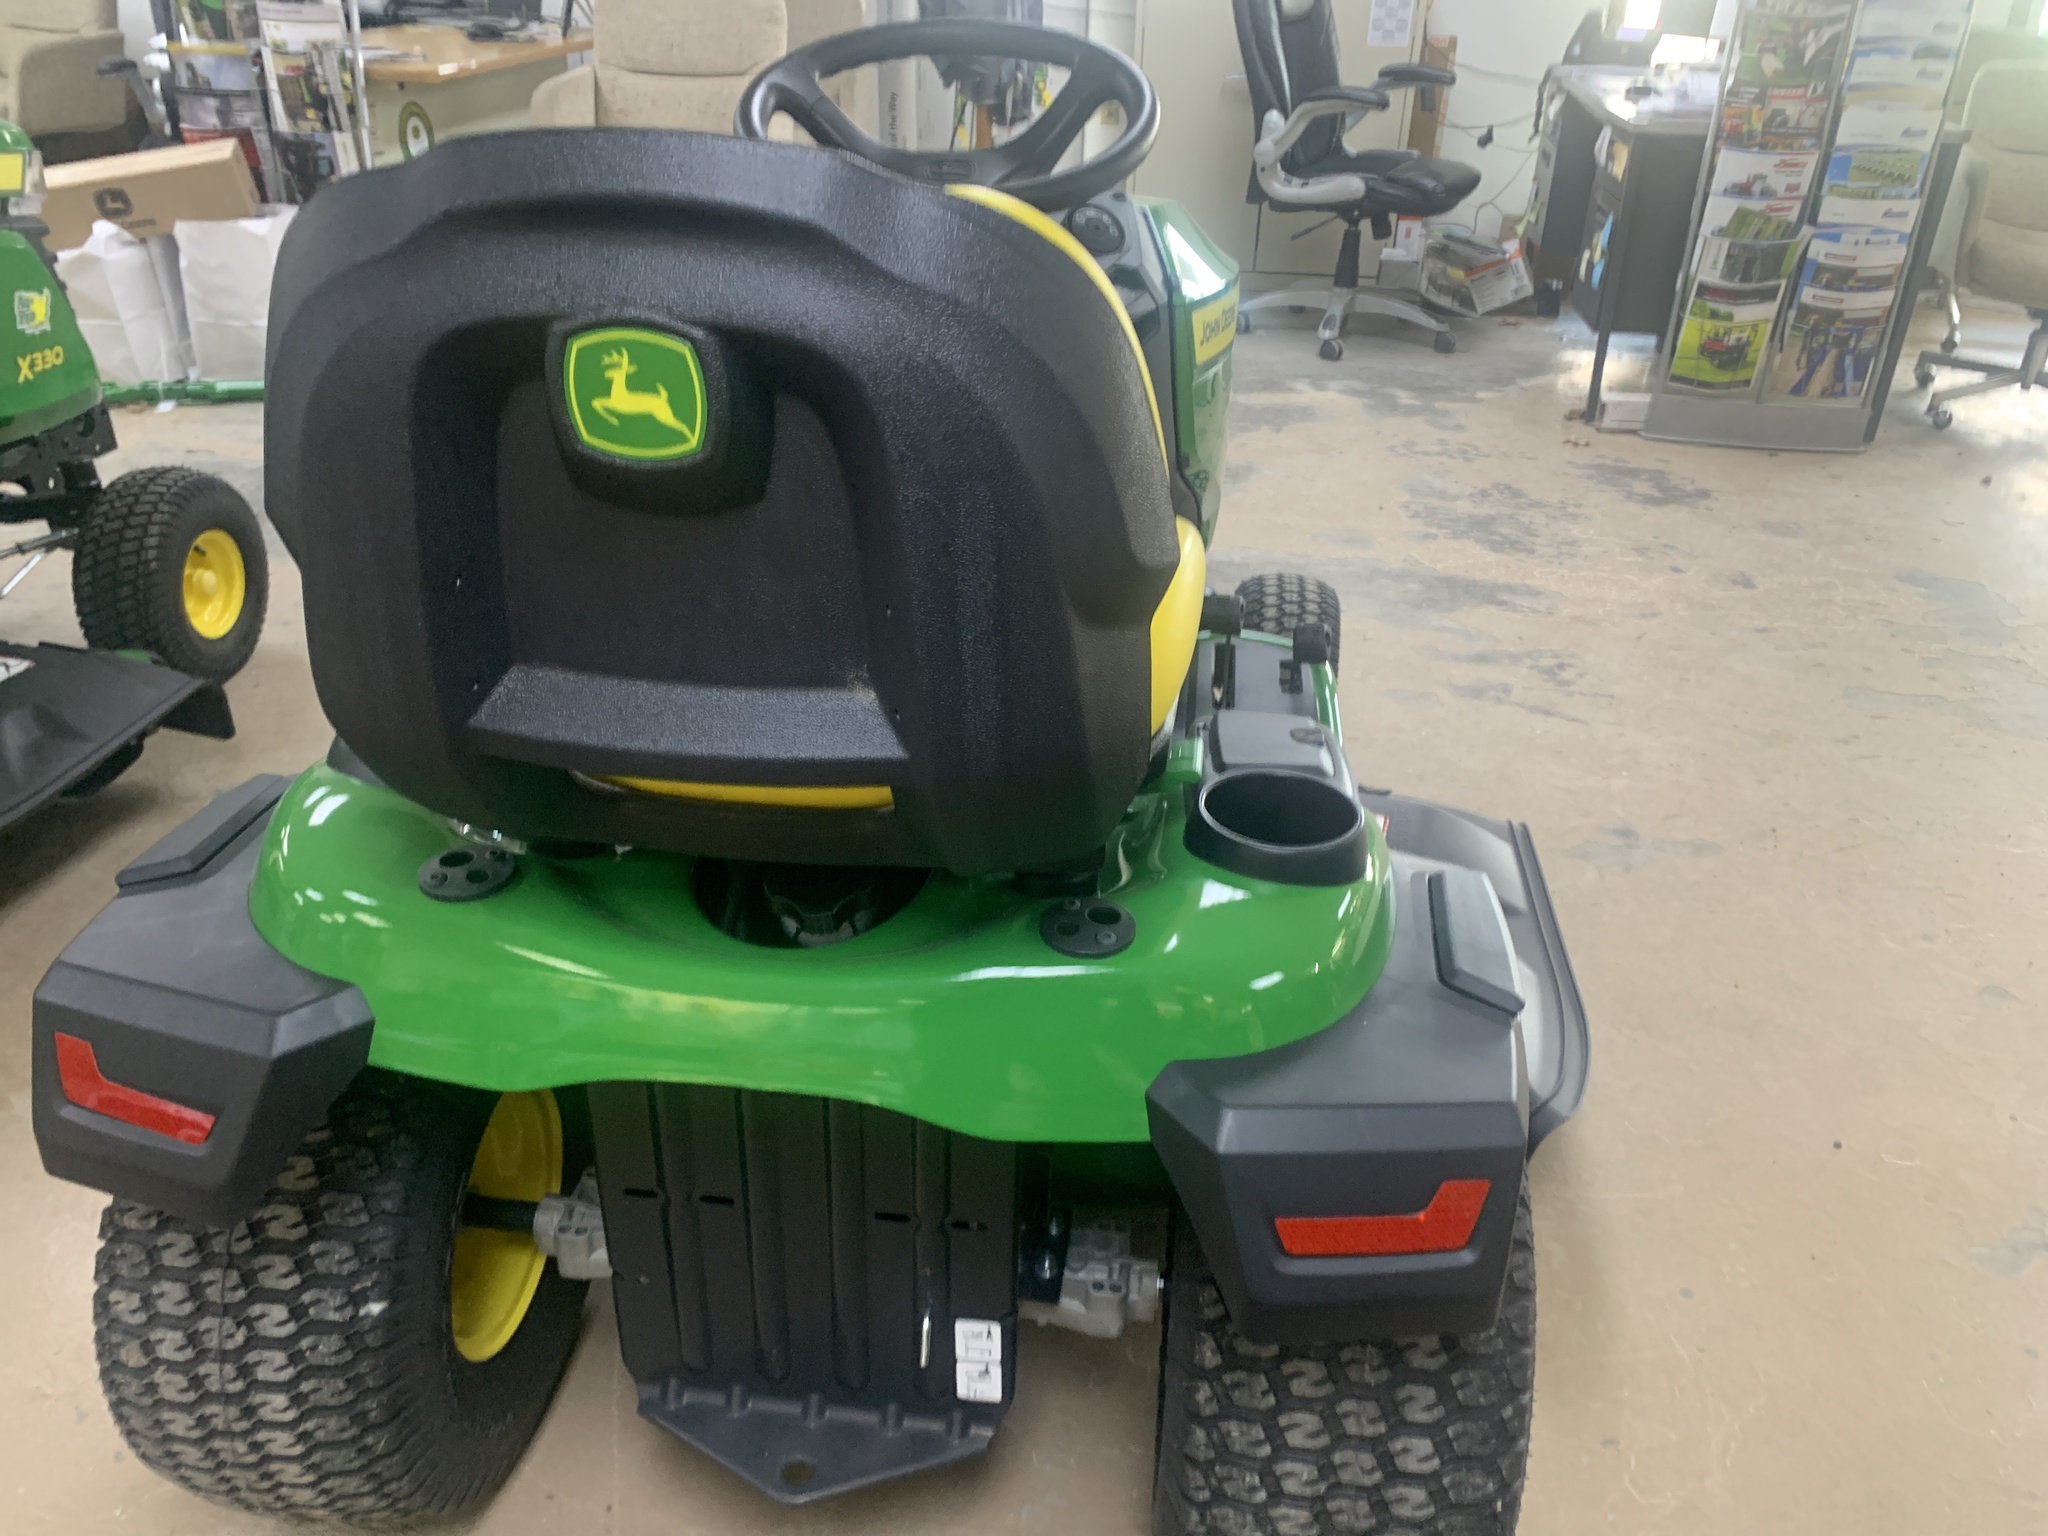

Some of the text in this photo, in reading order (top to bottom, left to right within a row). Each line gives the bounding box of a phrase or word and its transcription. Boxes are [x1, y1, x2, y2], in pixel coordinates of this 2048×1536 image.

[888, 91, 899, 112] Way
[888, 114, 897, 130] the
[1200, 317, 1220, 347] JOHN
[17, 345, 64, 384] X330
